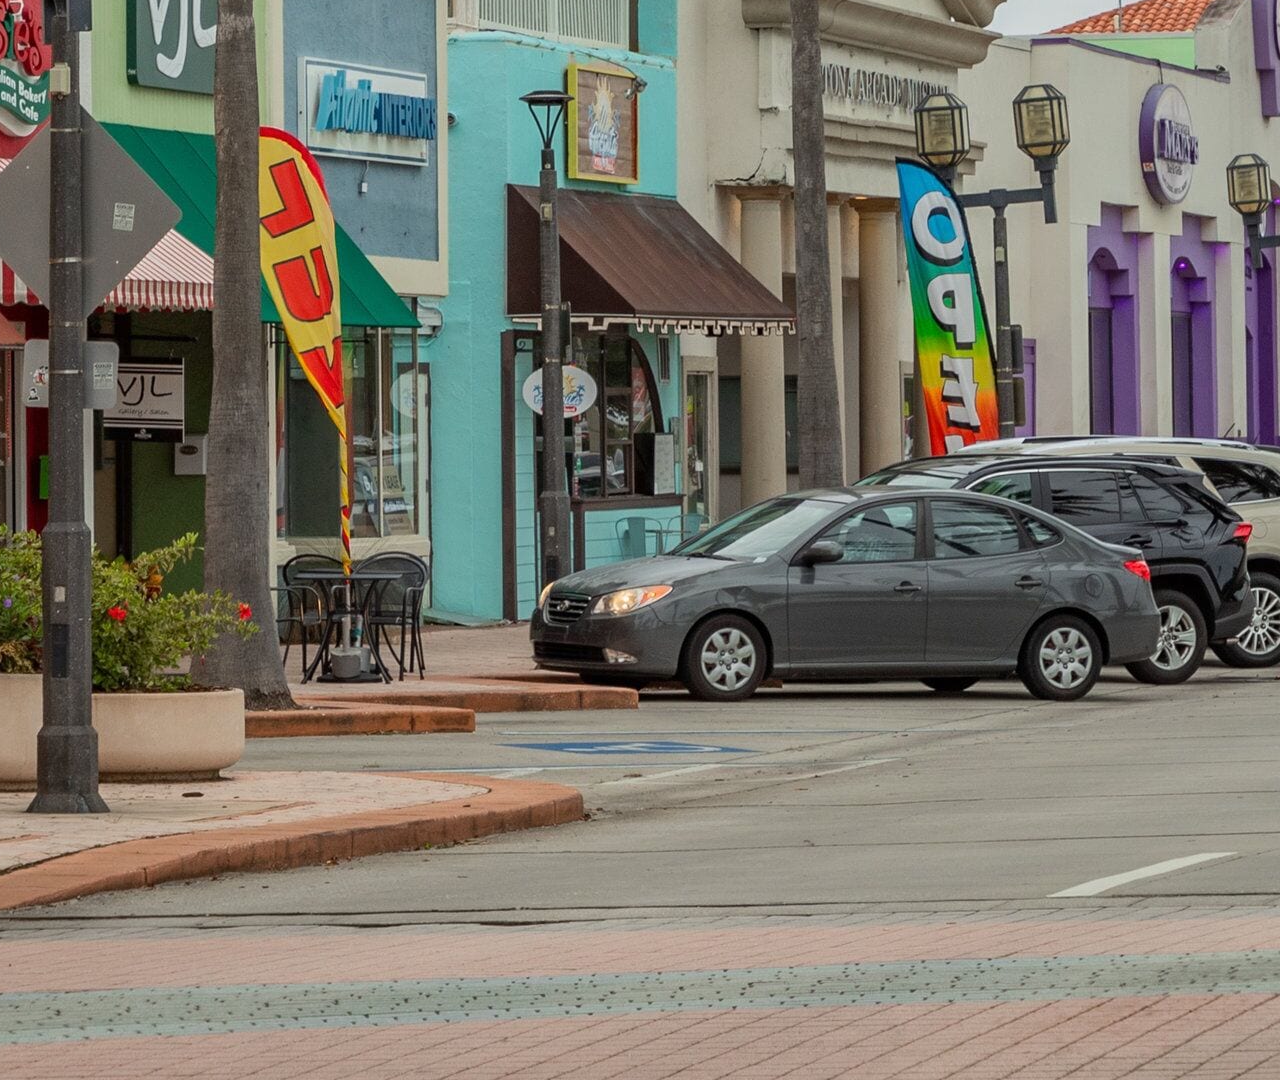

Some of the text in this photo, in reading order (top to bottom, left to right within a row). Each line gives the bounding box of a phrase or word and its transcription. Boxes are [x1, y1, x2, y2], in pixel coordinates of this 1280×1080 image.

[18, 78, 47, 104] Bakery
[858, 69, 903, 107] ARCADE
[1, 90, 40, 122] and Cafe
[316, 70, 437, 141] Atlantic INTERIORS
[117, 375, 173, 406] VJL
[118, 408, 143, 417] Gallery
